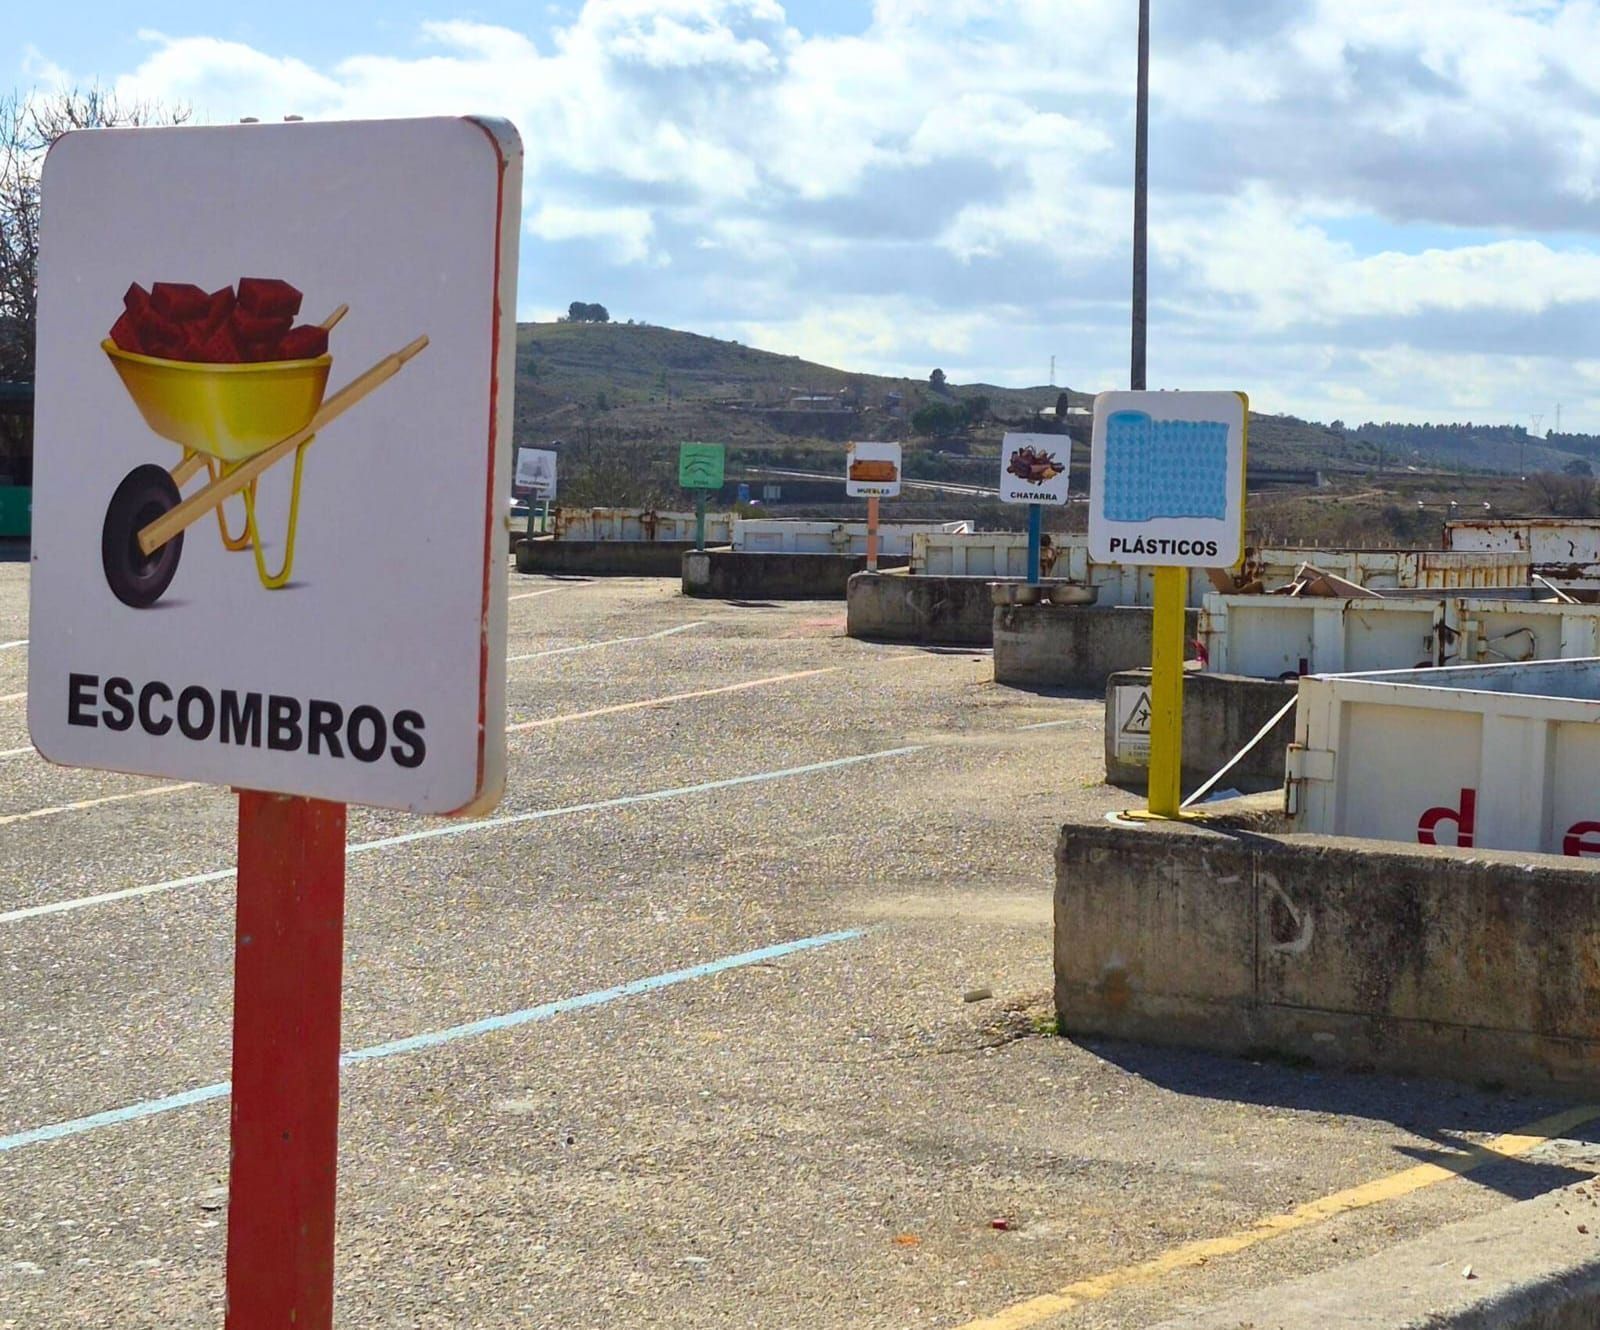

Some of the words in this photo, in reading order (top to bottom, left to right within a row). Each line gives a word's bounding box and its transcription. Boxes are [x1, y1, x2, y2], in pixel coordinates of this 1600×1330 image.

[1010, 491, 1058, 501] CHATARRA
[1109, 535, 1218, 556] PLÁSTICOS
[67, 672, 427, 769] ESCOMBROS
